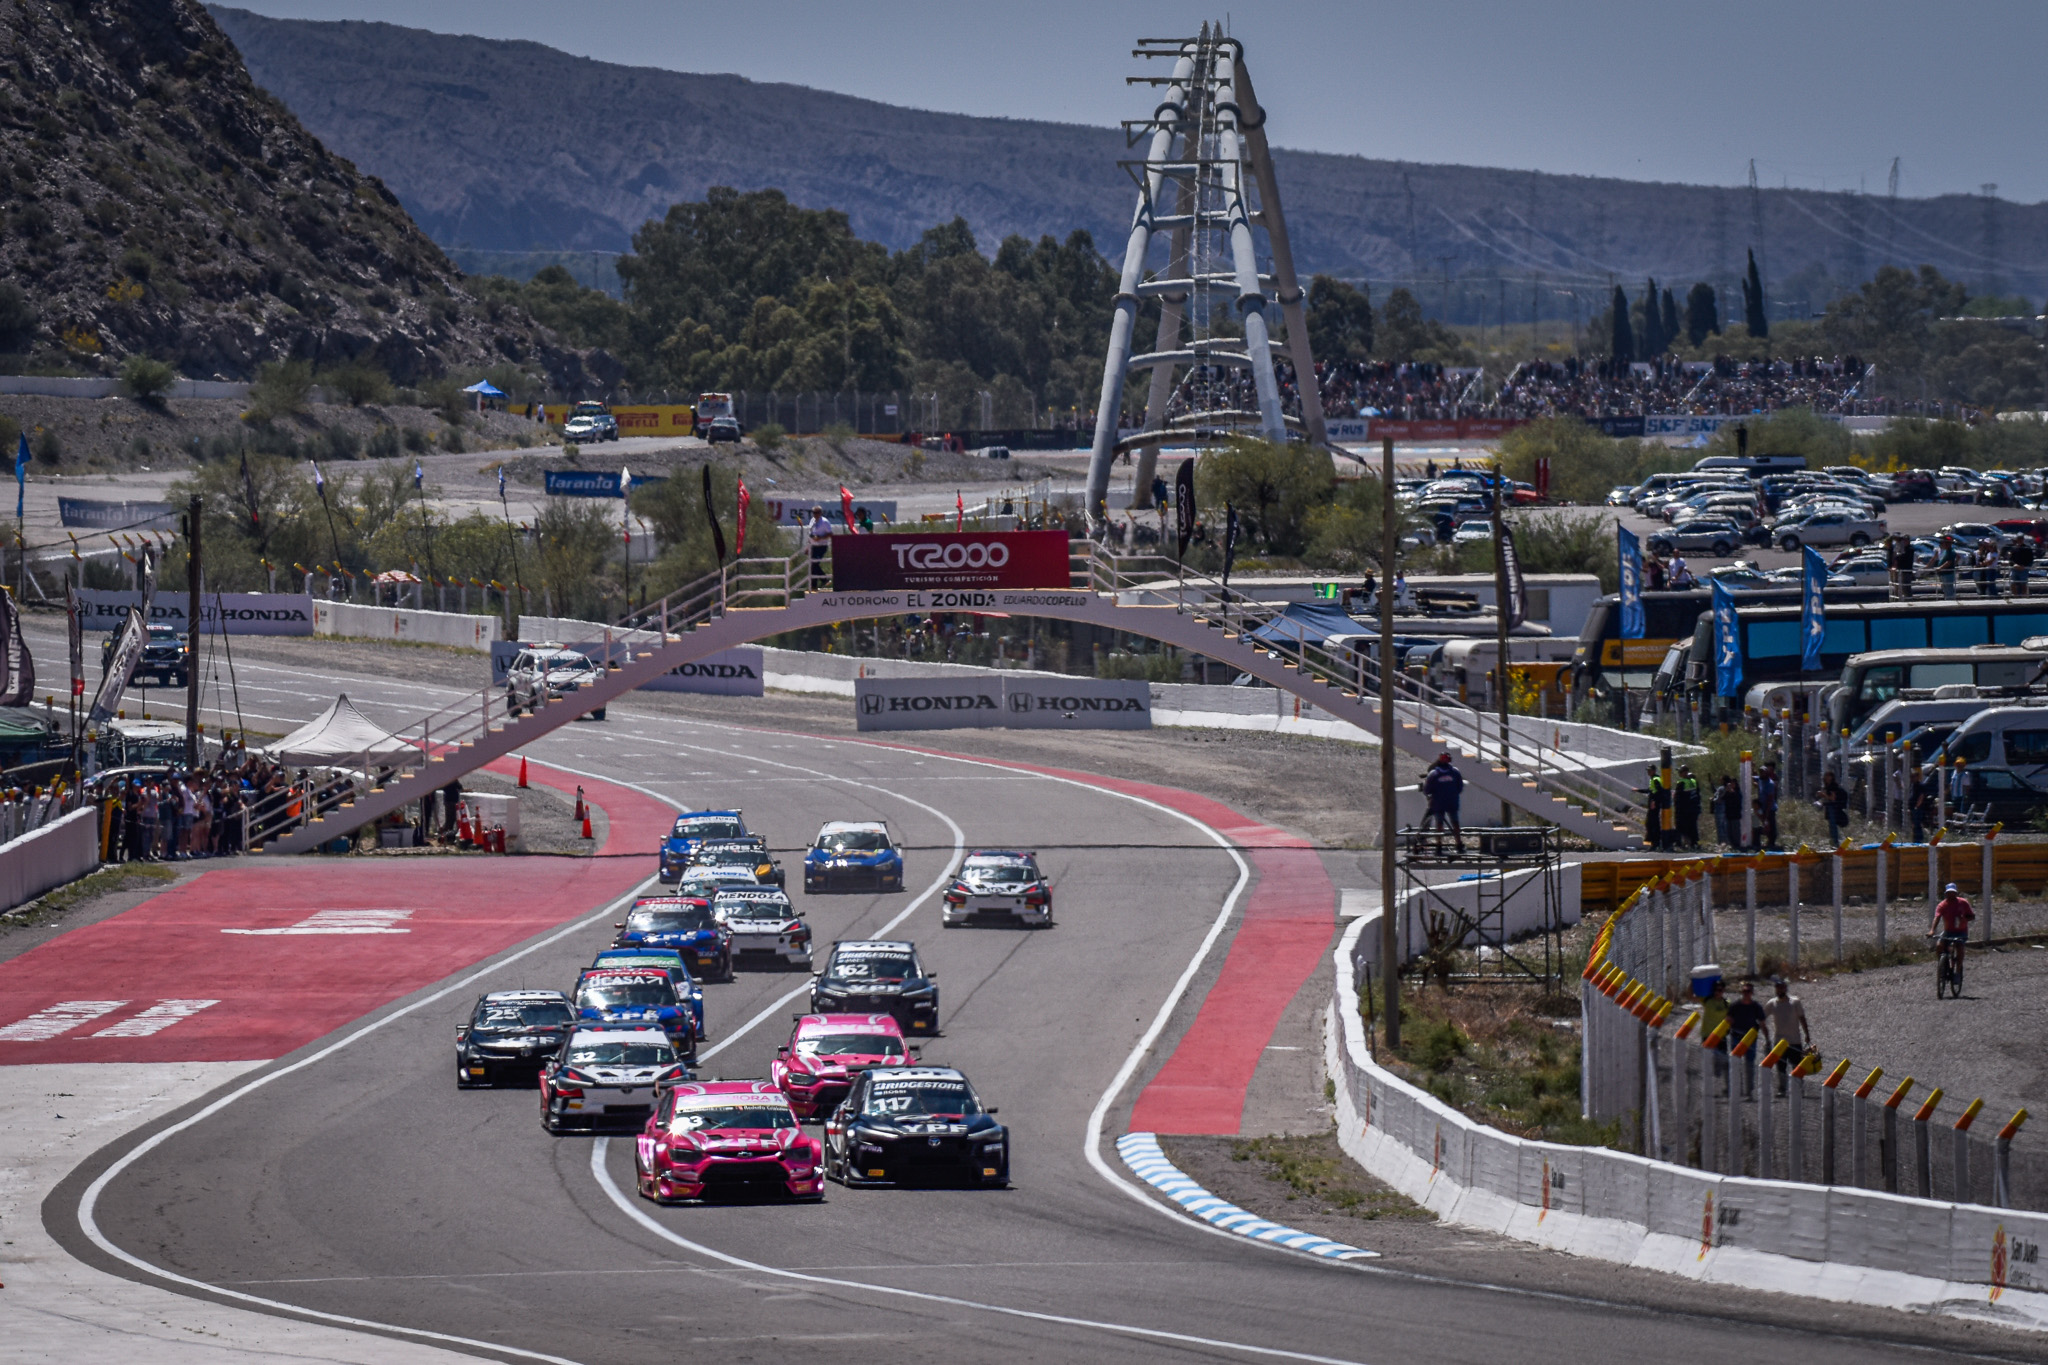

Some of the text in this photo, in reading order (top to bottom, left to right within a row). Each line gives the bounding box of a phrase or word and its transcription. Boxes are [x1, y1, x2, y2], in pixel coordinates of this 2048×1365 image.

[1647, 418, 1686, 432] SKF
[549, 475, 614, 489] taranto
[63, 502, 123, 521] taranto
[891, 542, 1010, 569] TC2000
[907, 593, 926, 607] EL
[931, 593, 997, 607] ZONDA
[220, 608, 308, 621] HONDA
[889, 695, 998, 711] HONDA
[1036, 697, 1146, 712] HONDA
[682, 883, 697, 892] 16
[717, 891, 785, 901] MENDOZA
[838, 952, 912, 961] BRIDGESTONE
[835, 964, 869, 976] 162
[571, 1051, 597, 1063] 32
[874, 1081, 965, 1091] BRIDGESTONE
[873, 1096, 913, 1111] 117
[903, 1123, 969, 1133] YPF
[712, 1138, 779, 1149] YPF
